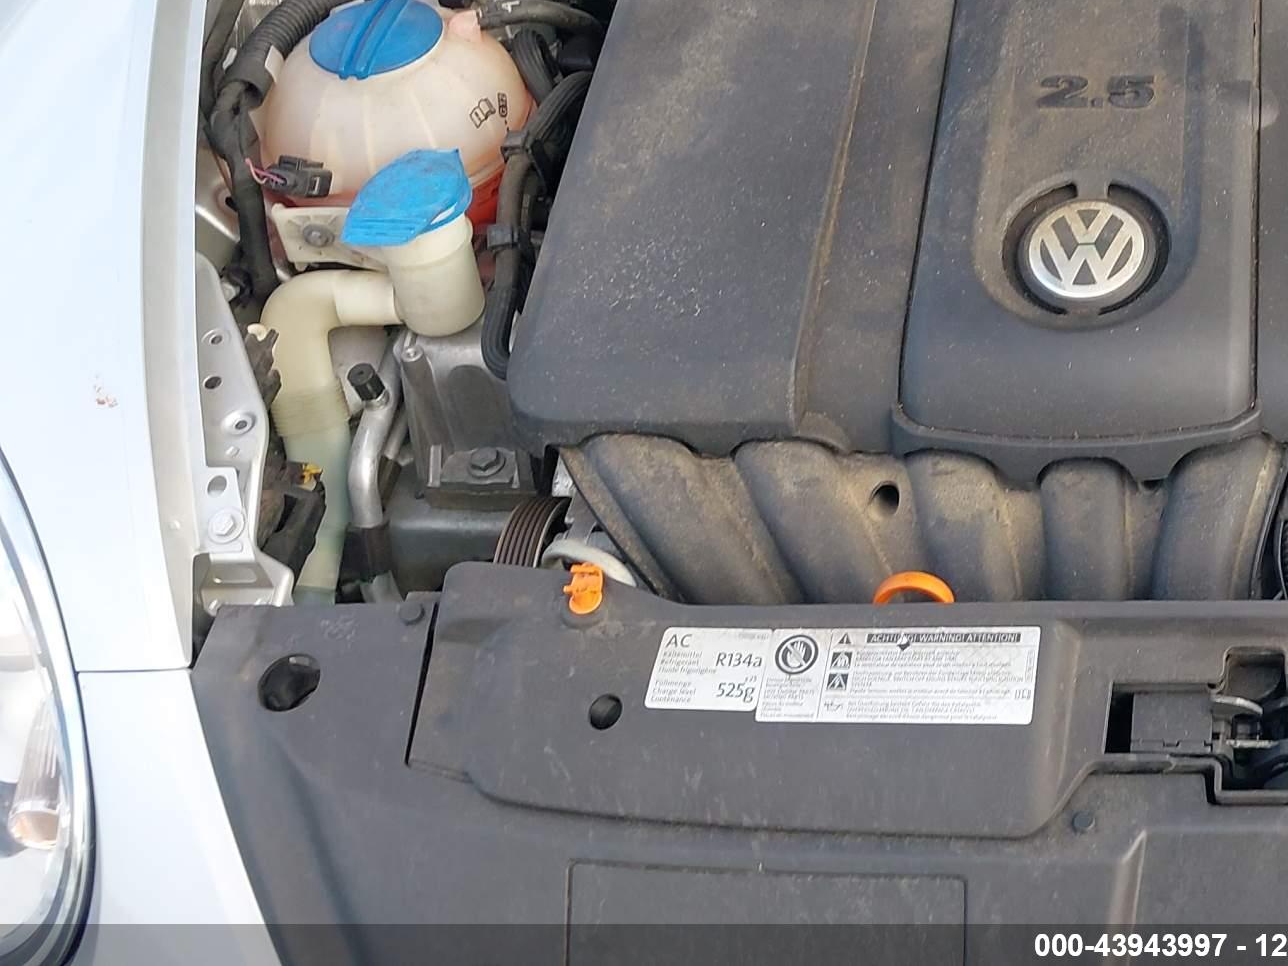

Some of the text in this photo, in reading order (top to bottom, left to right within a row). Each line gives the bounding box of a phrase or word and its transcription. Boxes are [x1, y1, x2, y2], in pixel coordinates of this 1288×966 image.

[1037, 74, 1156, 109] 2.5
[1029, 200, 1145, 298] VW
[665, 633, 692, 648] AC
[918, 633, 965, 643] WARNING!
[965, 633, 1018, 643] ATTENTION!
[715, 652, 763, 668] R134a
[716, 682, 756, 703] 525g
